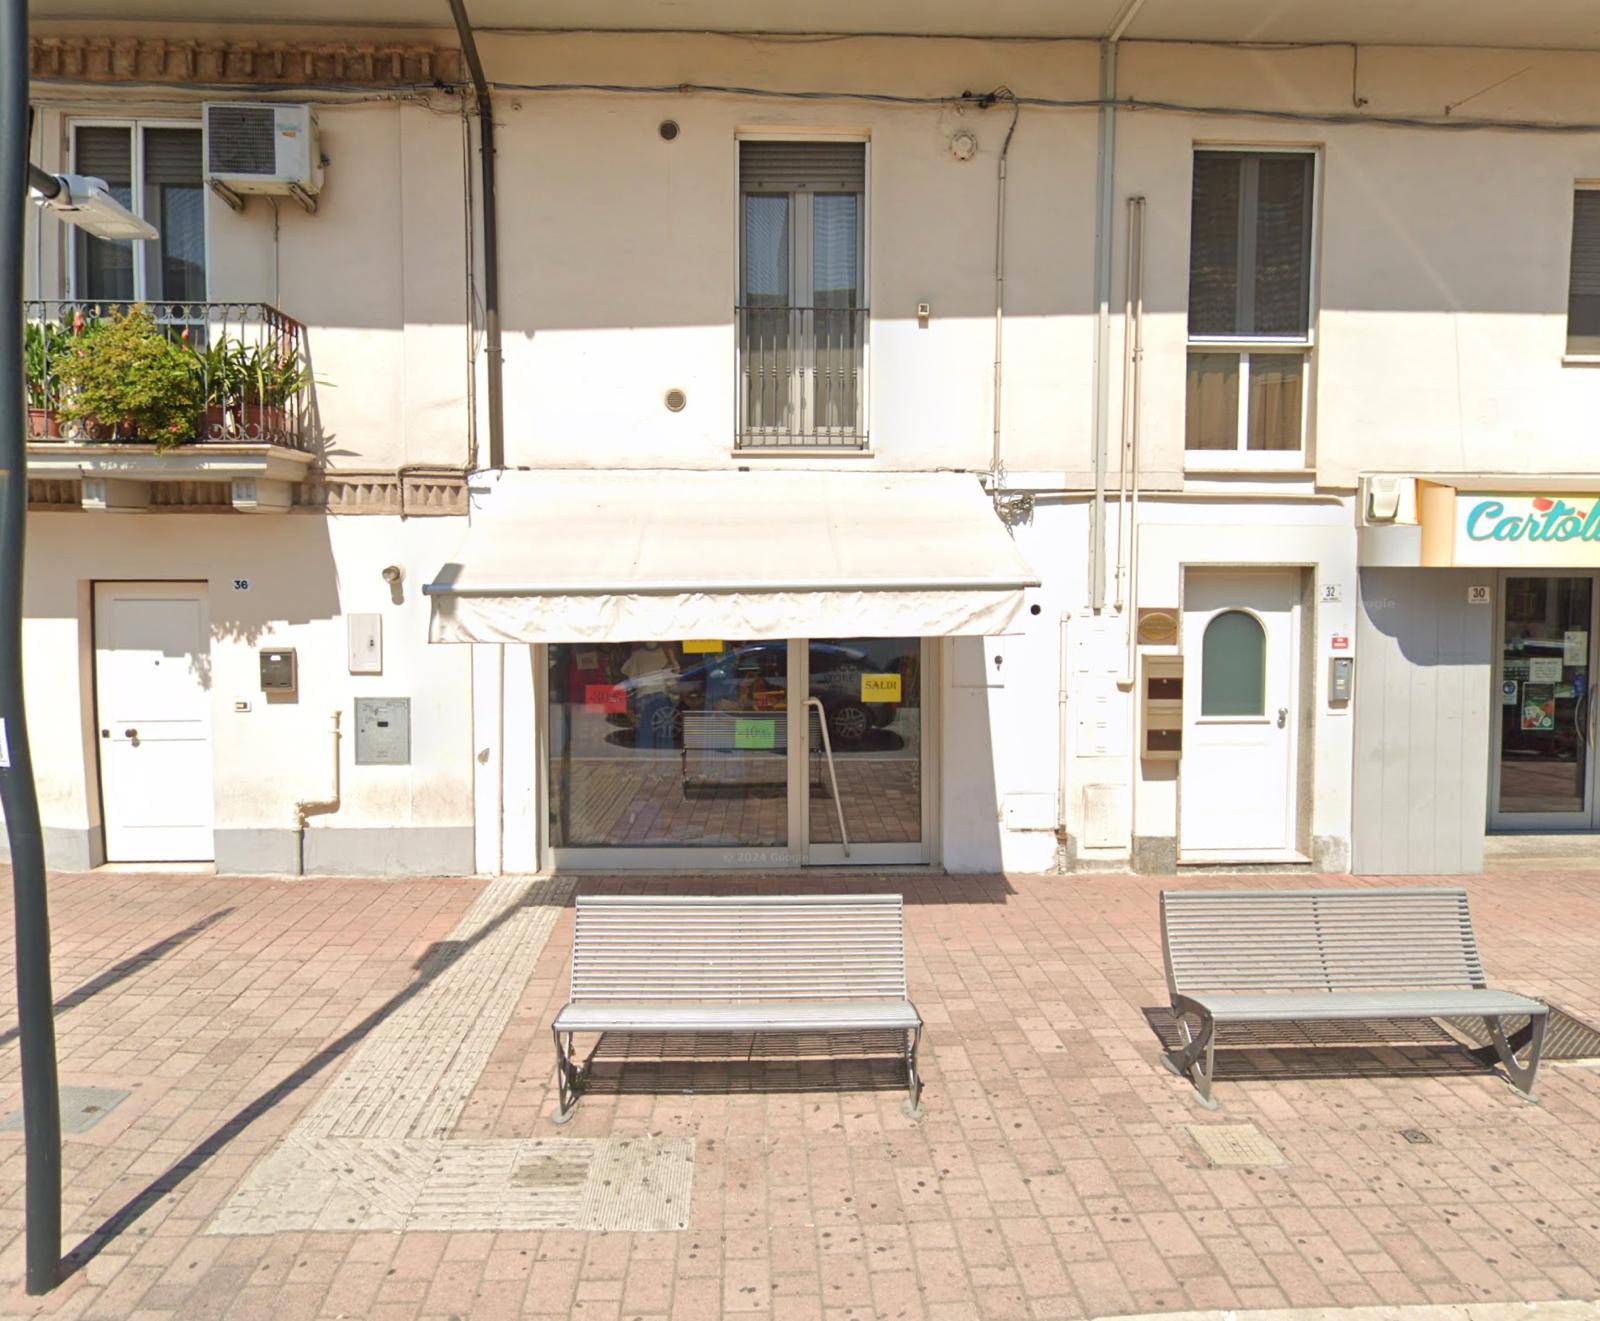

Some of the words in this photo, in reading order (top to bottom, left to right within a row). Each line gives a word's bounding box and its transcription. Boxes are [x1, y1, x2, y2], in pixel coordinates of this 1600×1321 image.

[233, 580, 248, 590] 36
[1325, 586, 1336, 597] 32
[1472, 587, 1486, 599] 30
[864, 680, 897, 690] SALDI
